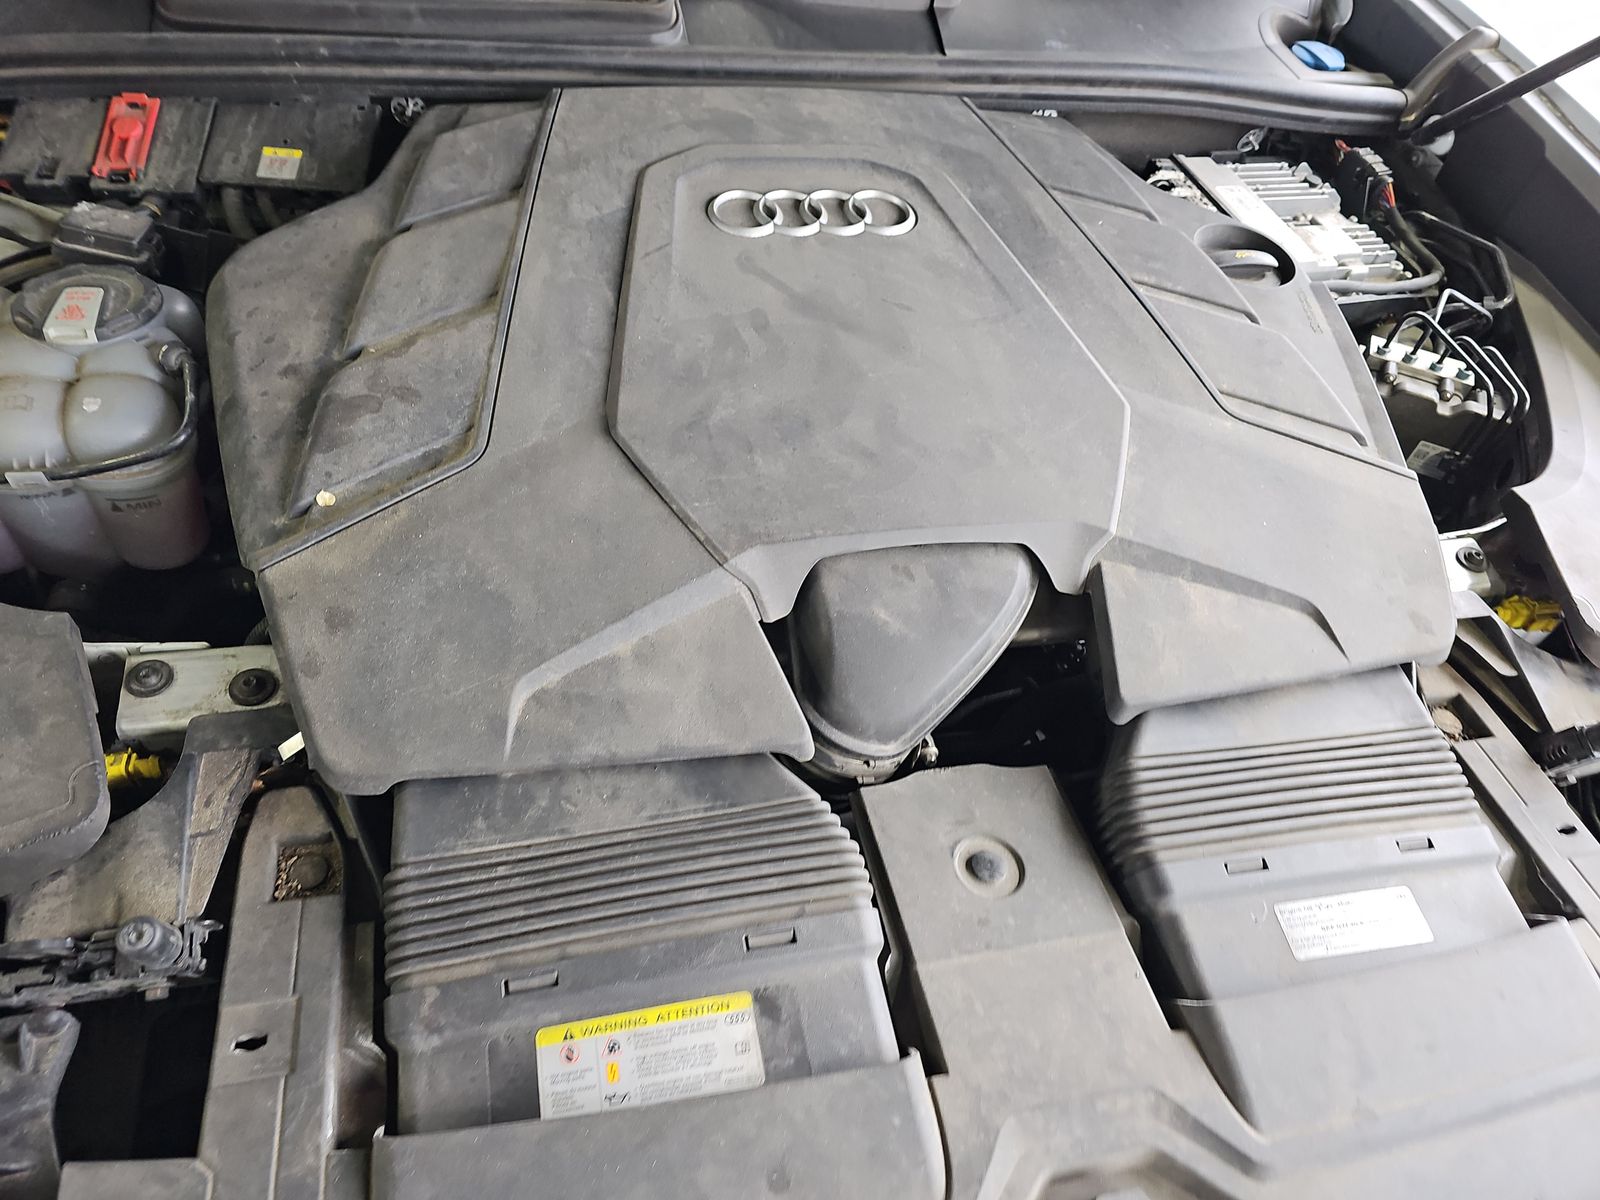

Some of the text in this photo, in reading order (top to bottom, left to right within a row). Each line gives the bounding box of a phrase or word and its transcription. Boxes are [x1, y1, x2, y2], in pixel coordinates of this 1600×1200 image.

[126, 498, 162, 512] MIN
[582, 1017, 648, 1036] WARNING
[655, 1001, 731, 1023] ATTENTION
